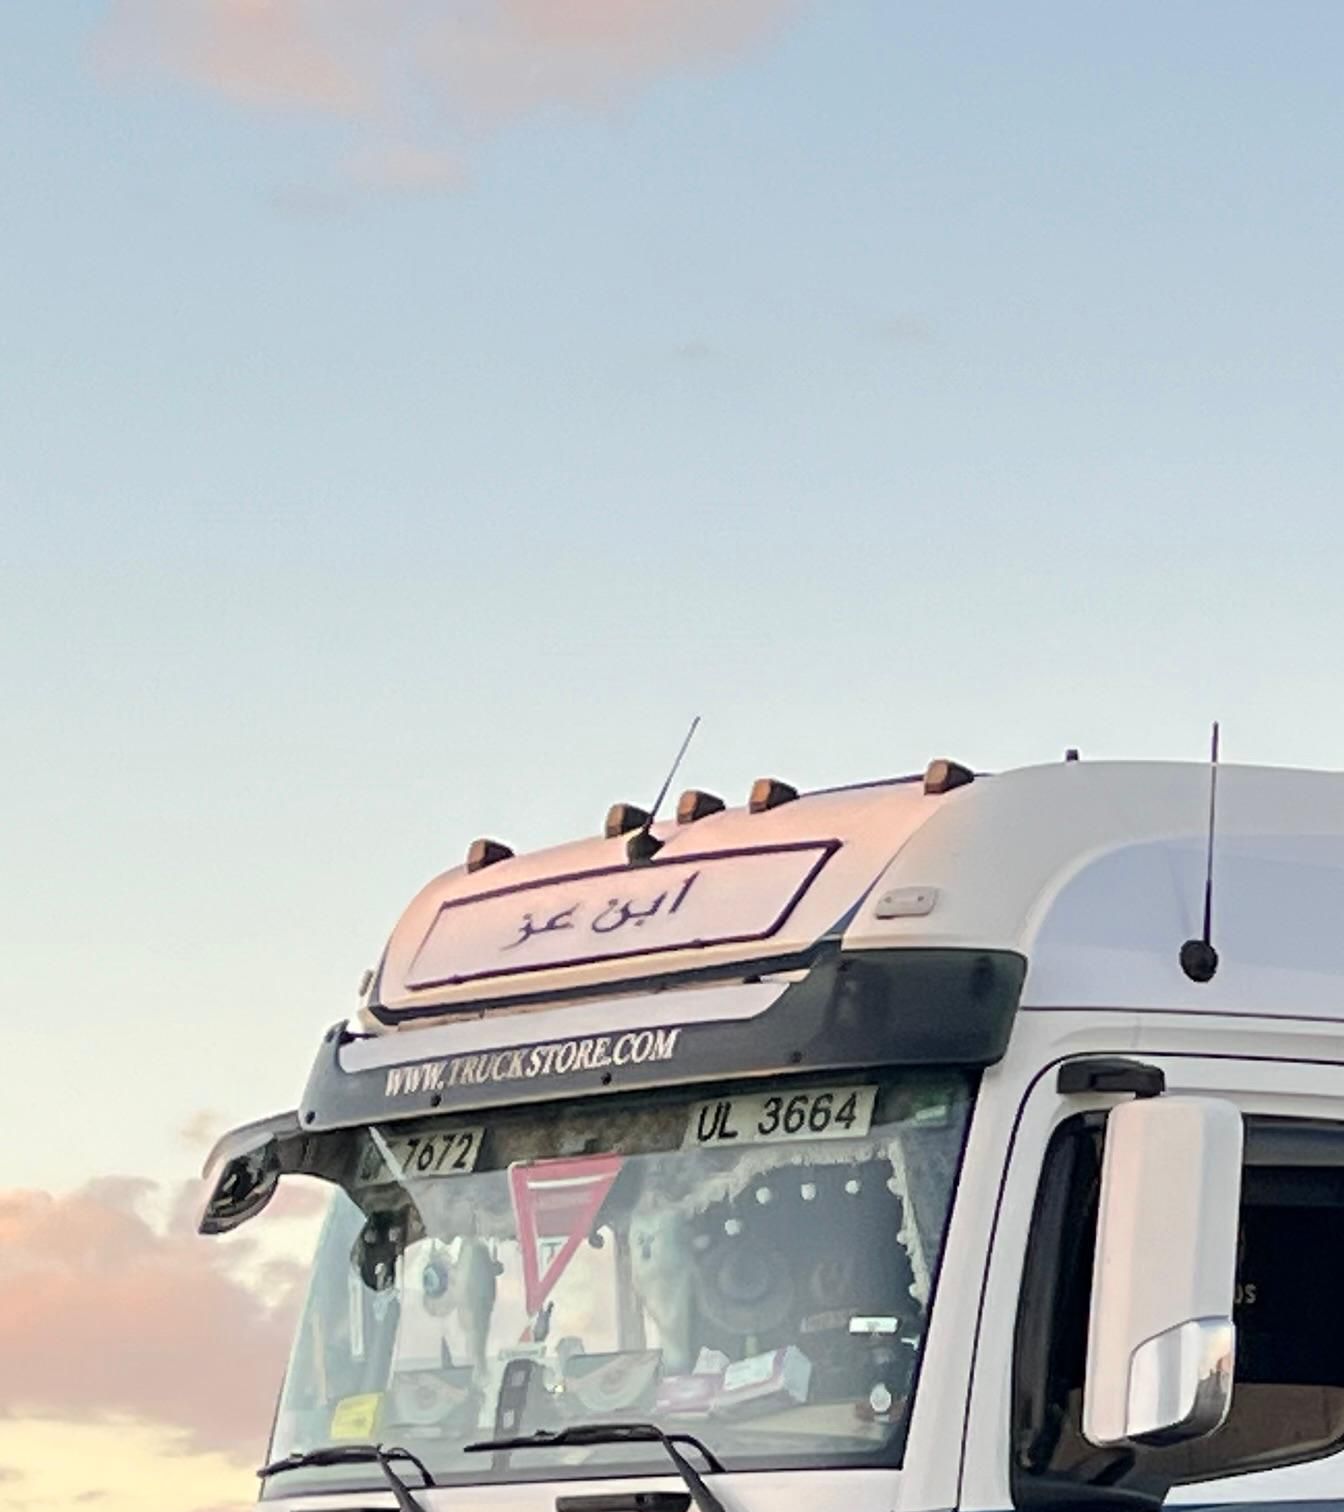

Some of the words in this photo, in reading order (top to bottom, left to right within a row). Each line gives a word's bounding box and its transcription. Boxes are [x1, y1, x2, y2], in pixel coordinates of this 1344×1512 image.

[384, 1029, 682, 1097] WWW.TRUCKSTORE.COM
[697, 1101, 738, 1143] UL
[757, 1091, 858, 1136] 3664
[402, 1132, 474, 1172] 7672
